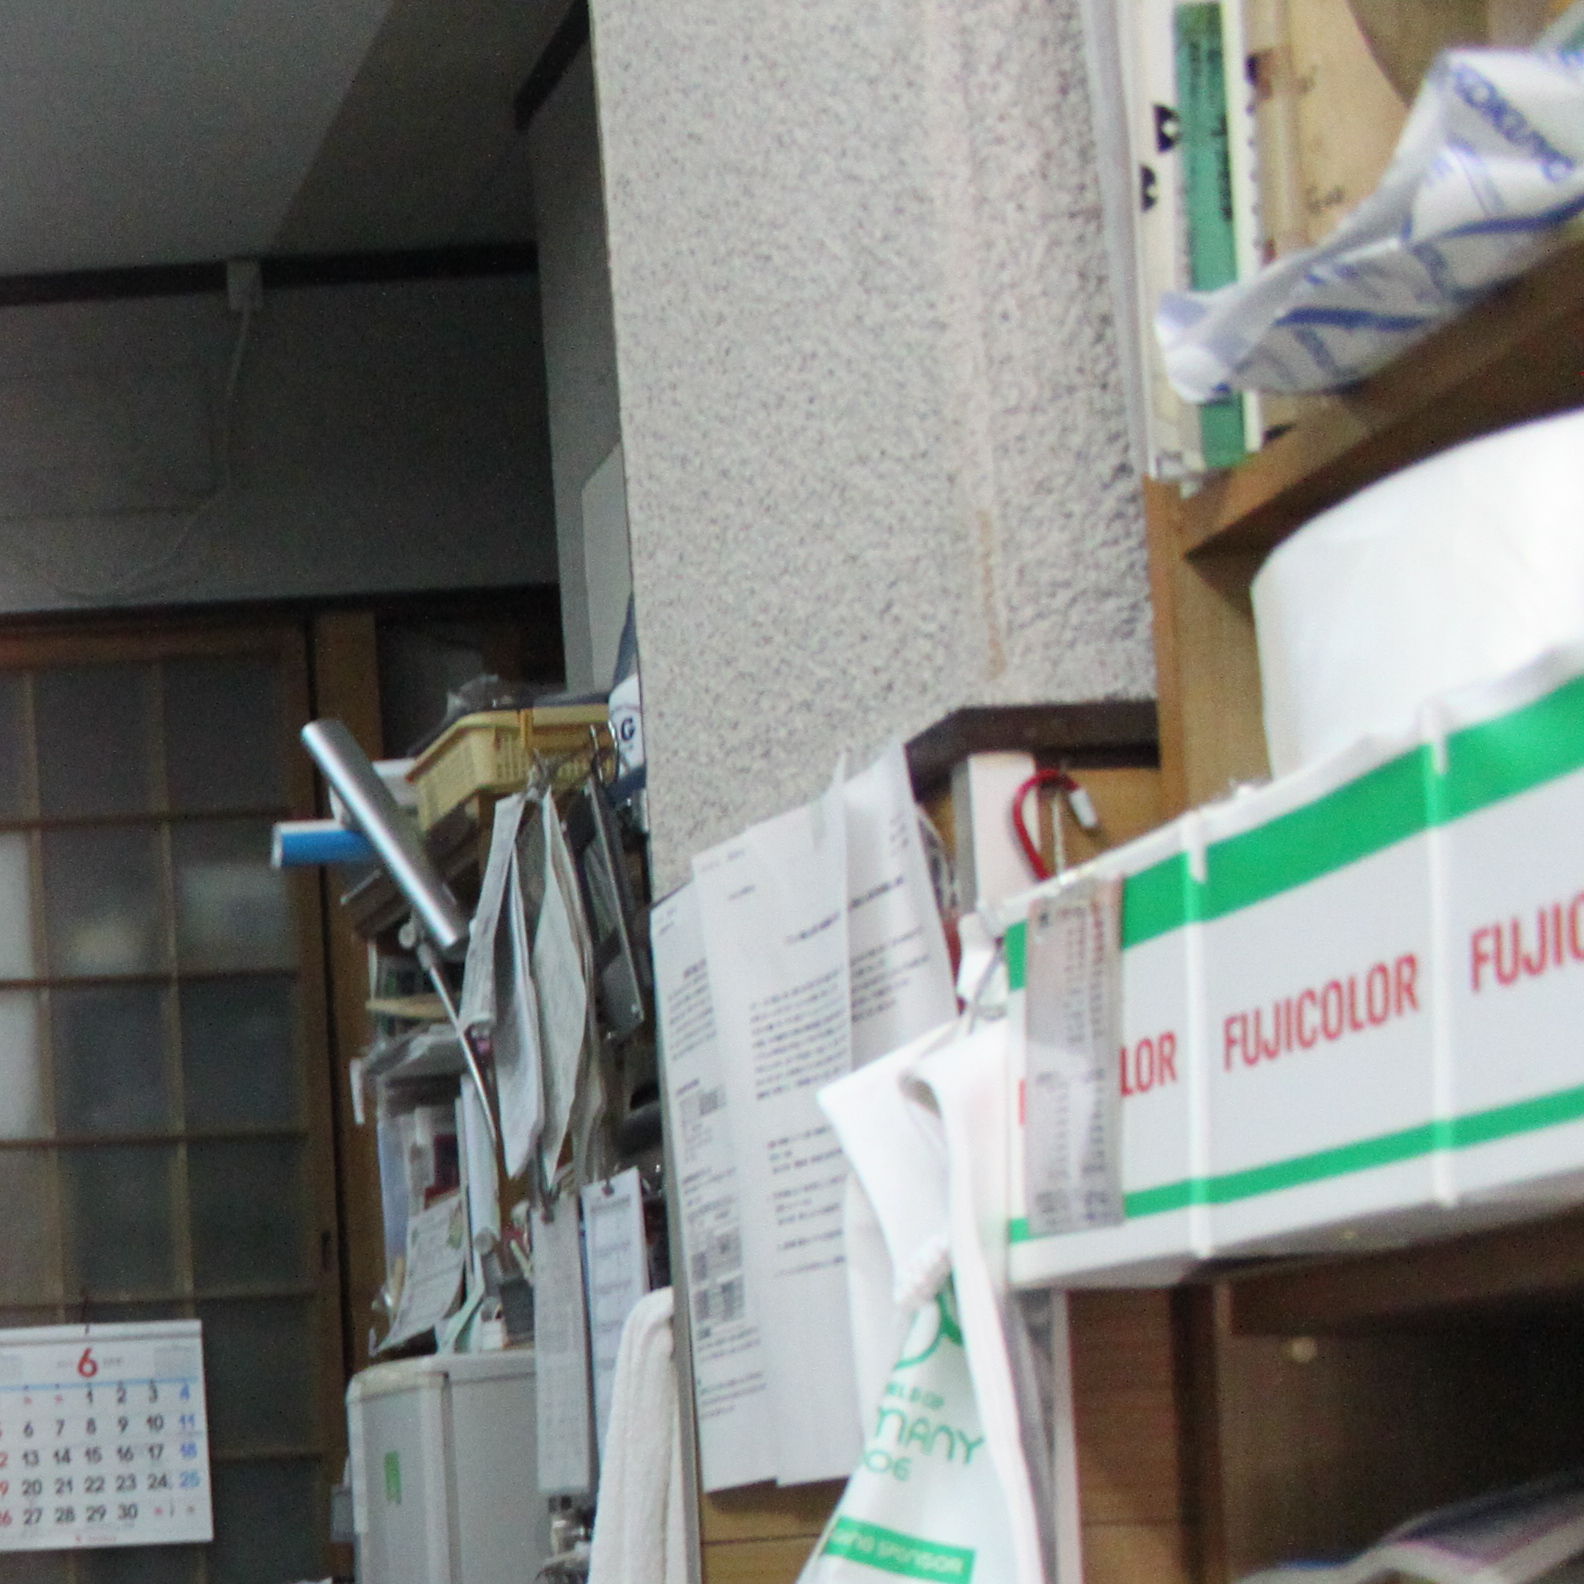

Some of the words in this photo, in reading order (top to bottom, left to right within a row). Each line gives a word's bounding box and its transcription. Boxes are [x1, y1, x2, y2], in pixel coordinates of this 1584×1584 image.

[1223, 954, 1421, 1072] FUJICOLOR
[78, 1348, 98, 1378] 6
[22, 1450, 39, 1468] 13
[53, 1448, 71, 1466] 14
[147, 1443, 165, 1461] 17
[22, 1479, 42, 1497] 20
[54, 1478, 73, 1495] 21
[85, 1476, 105, 1494] 22
[115, 1474, 137, 1492] 23
[147, 1473, 168, 1491] 24
[23, 1508, 42, 1526] 27
[55, 1506, 75, 1524] 28
[86, 1504, 106, 1523] 29
[118, 1502, 138, 1521] 30
